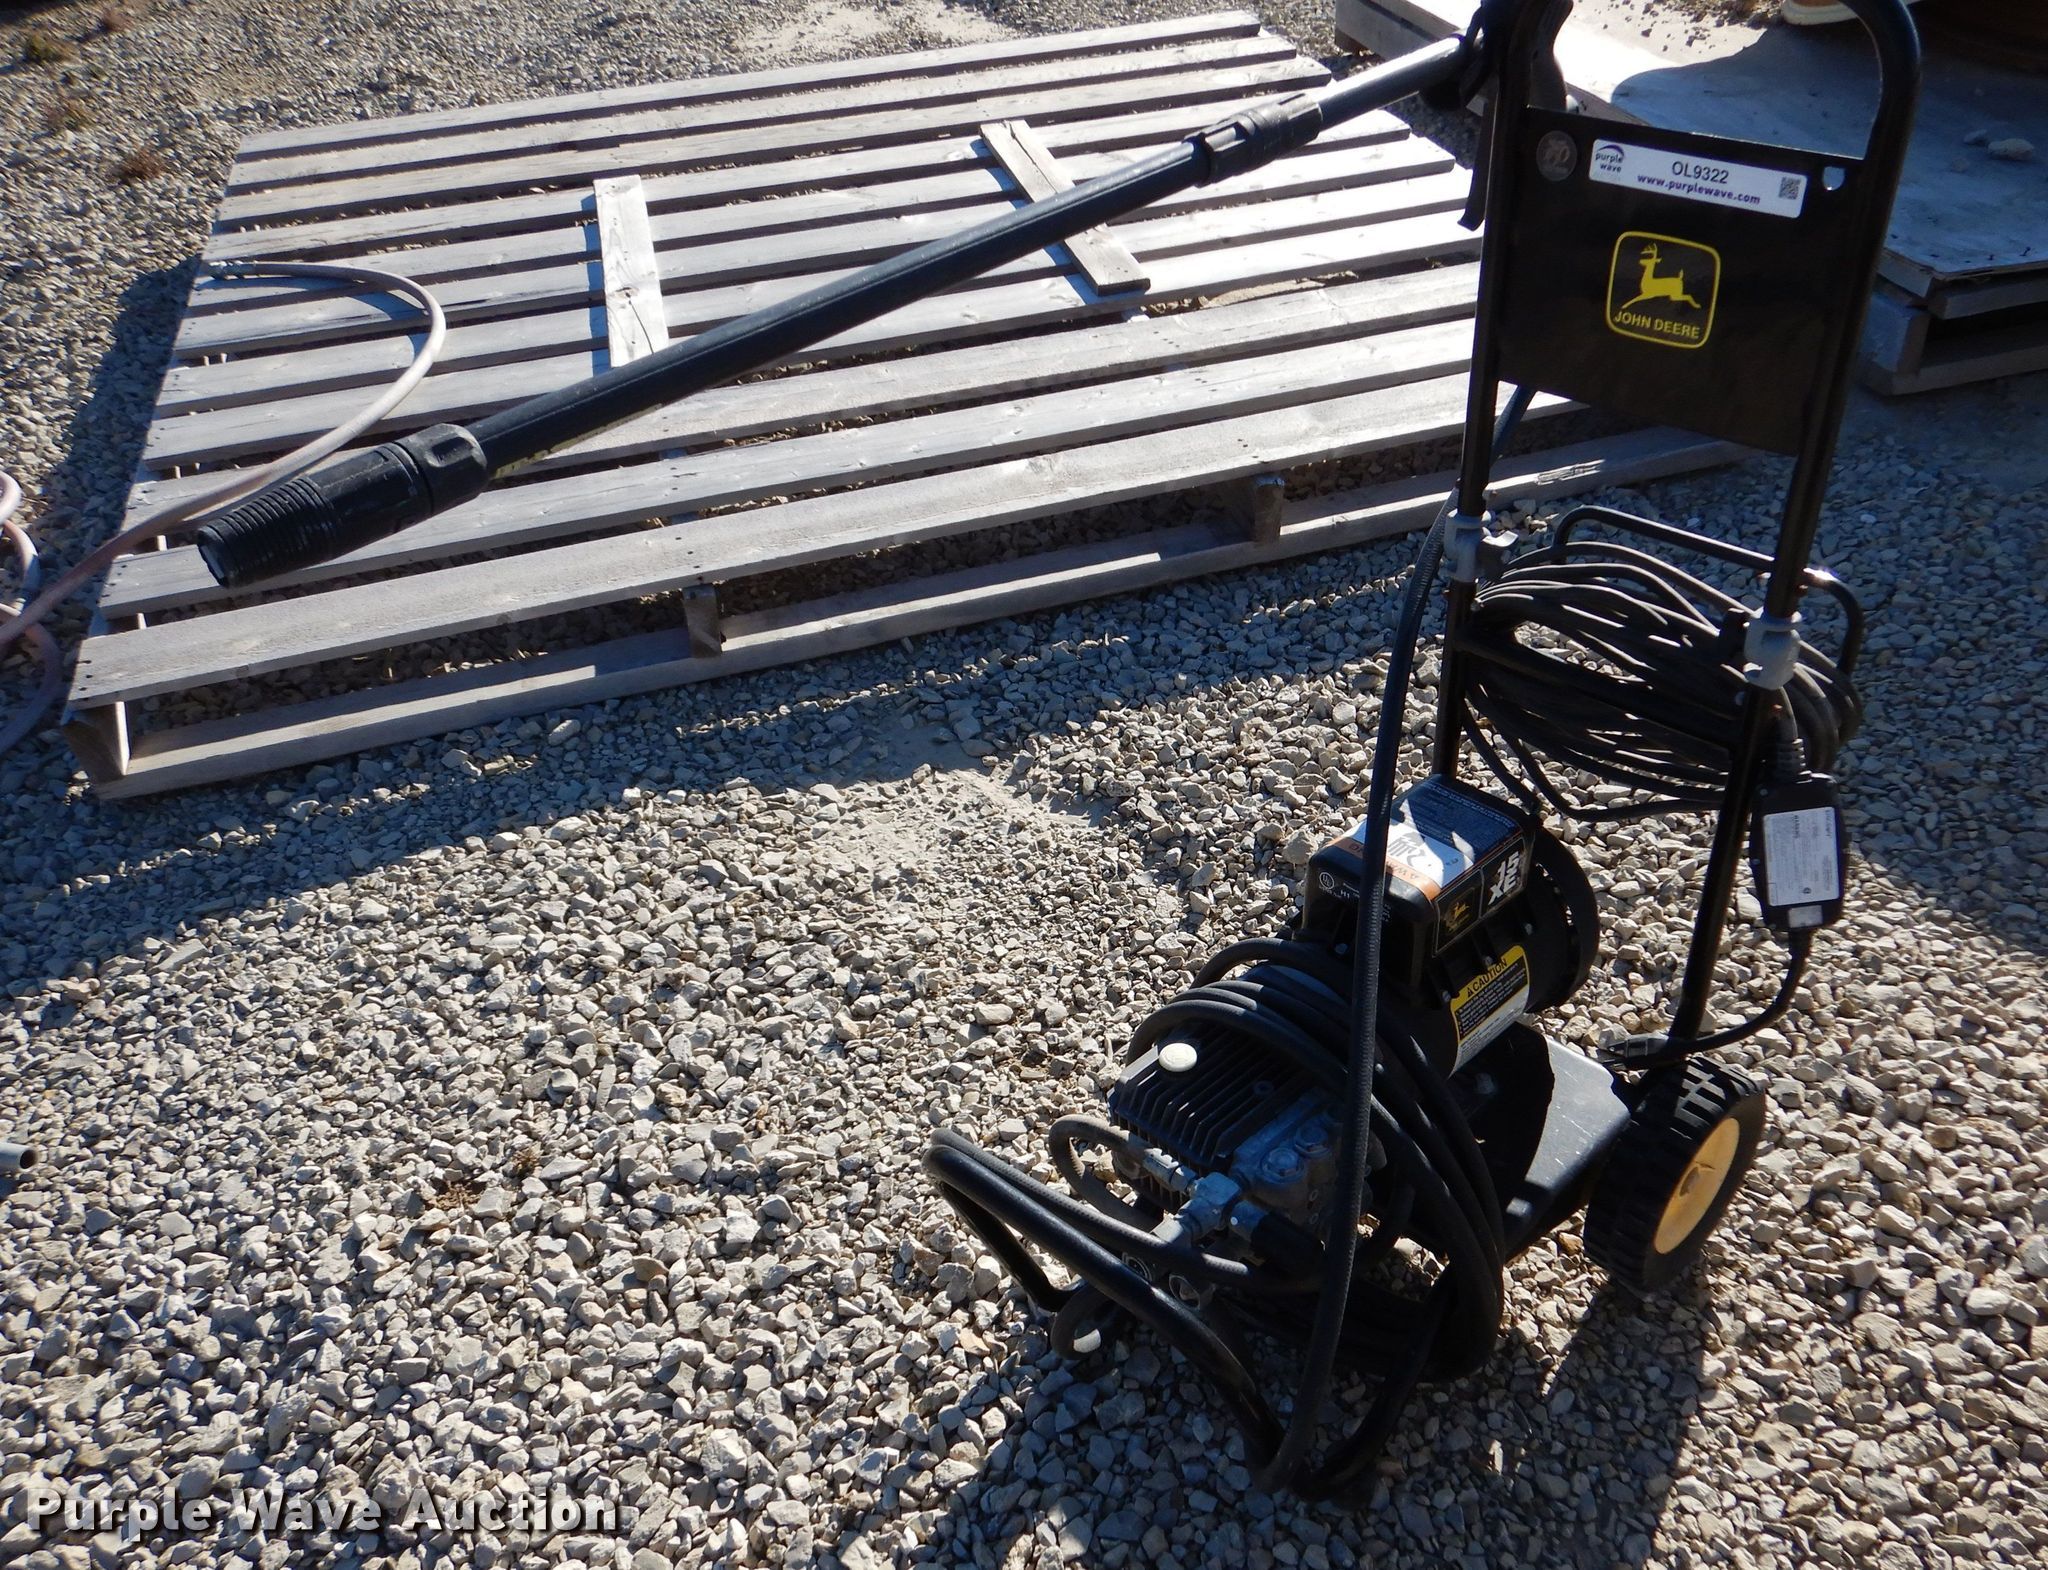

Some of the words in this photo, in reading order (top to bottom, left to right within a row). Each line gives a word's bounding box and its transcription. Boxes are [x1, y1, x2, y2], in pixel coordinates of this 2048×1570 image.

[1595, 151, 1624, 164] purple
[1600, 163, 1622, 173] wave
[1672, 160, 1730, 184] OL9322
[1637, 173, 1761, 205] www.purplewave.com
[1614, 310, 1651, 329] JOHN
[1654, 319, 1700, 339] DEERE
[1497, 851, 1520, 881] 15
[1487, 868, 1518, 905] XE
[1472, 958, 1508, 992] CAUTION
